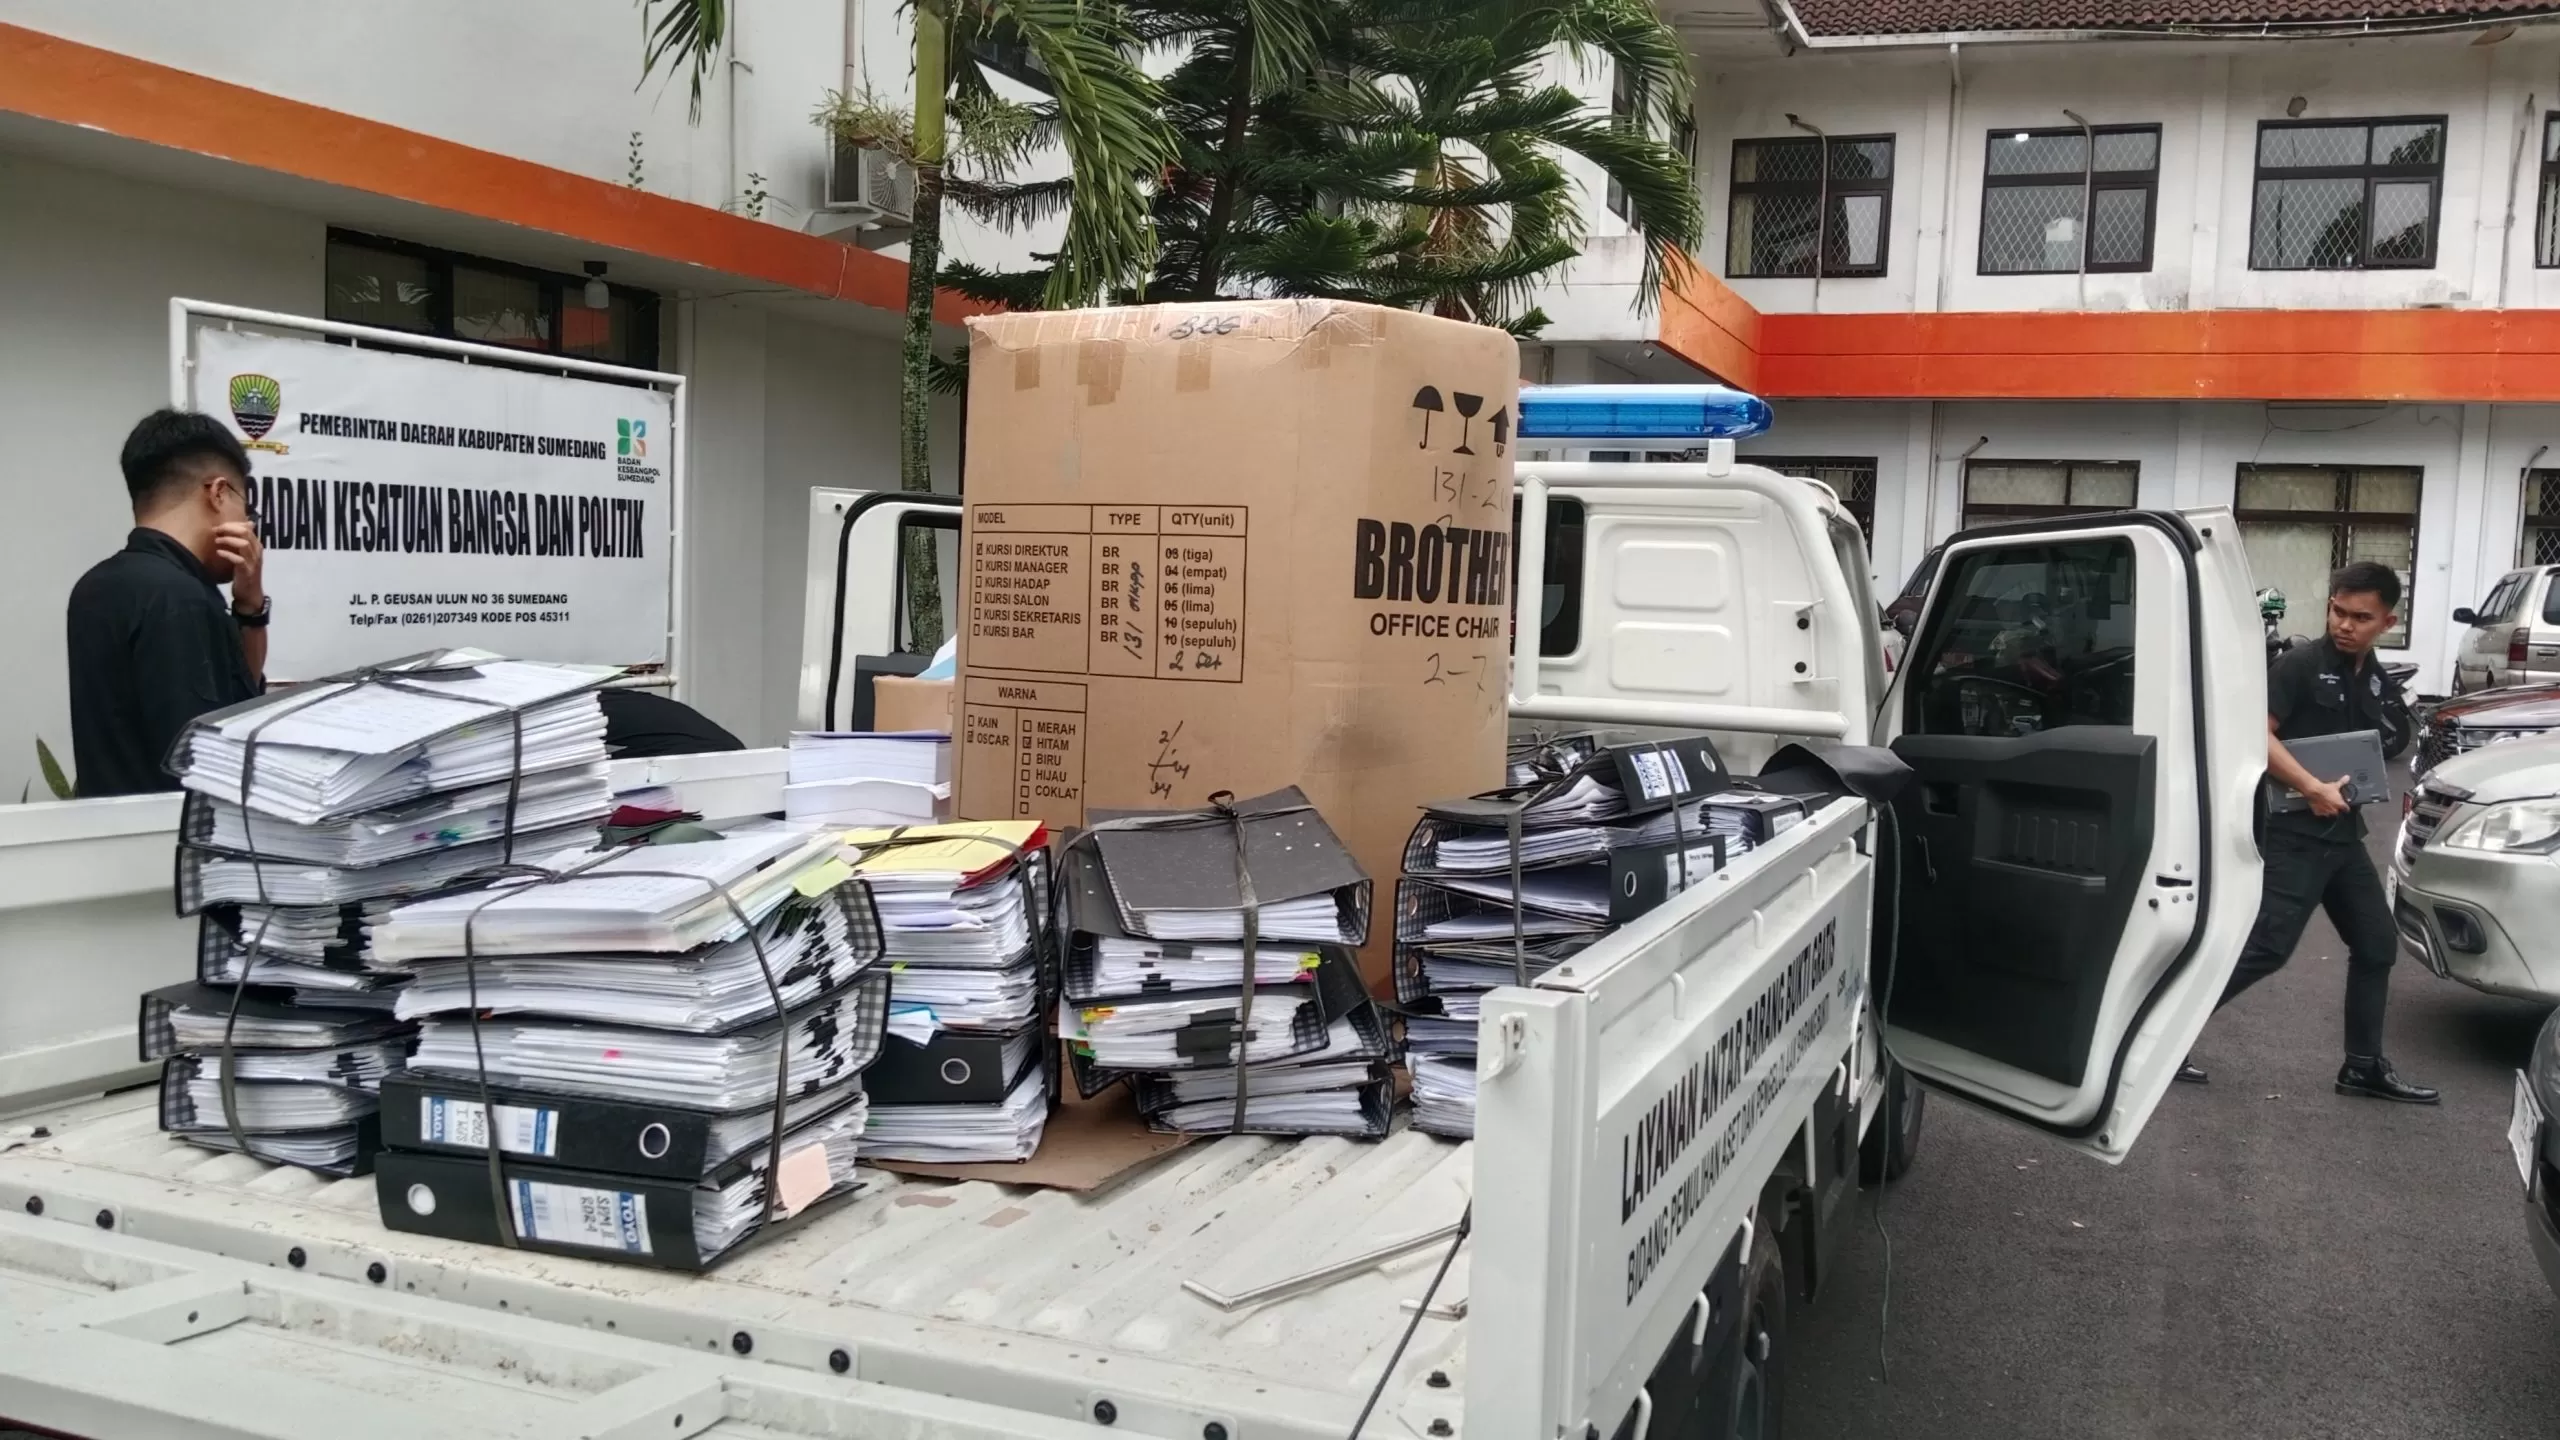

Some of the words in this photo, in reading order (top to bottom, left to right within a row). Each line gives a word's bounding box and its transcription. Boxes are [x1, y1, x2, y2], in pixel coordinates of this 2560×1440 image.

[300, 412, 397, 442] PEMERINTAH
[400, 421, 455, 447] DAERAH
[458, 427, 535, 455] KABUPATEN
[537, 435, 606, 460] SUMEDANG
[617, 456, 641, 466] BADAN
[617, 466, 661, 476] KESBANGPOL
[617, 473, 655, 484] SUMEDANG
[333, 481, 443, 554] KESATUAN
[447, 487, 531, 557] BANGSA
[535, 491, 574, 557] DAN
[578, 495, 645, 559] POLITIK
[977, 512, 1006, 524] MODEL
[1109, 513, 1142, 526] TYPE
[1171, 513, 1235, 529] QTY(unit)
[986, 544, 1012, 555] KURSI
[1014, 544, 1069, 557] DIREKTUR
[1102, 546, 1120, 558] BR
[1182, 549, 1213, 563] (tiga)
[1354, 518, 1509, 606] BROTHER
[985, 560, 1012, 572] KURSI
[1014, 561, 1068, 574] MANAGER
[1102, 563, 1120, 575] BR
[1182, 565, 1227, 580] (empat)
[985, 577, 1011, 589] KURSI
[1013, 578, 1050, 590] HADAP
[1101, 580, 1119, 592] BR
[1181, 583, 1215, 598] (lima)
[349, 594, 367, 605] JL.
[371, 594, 380, 605] P.
[384, 594, 432, 605] GEUSAN
[436, 594, 468, 605] ULUN
[471, 594, 488, 604] NO
[491, 594, 505, 604] 36
[507, 594, 568, 604] SUMEDANG
[984, 594, 1011, 606] KURSI
[1013, 594, 1049, 607] SALON
[1101, 597, 1119, 609] BR
[1181, 600, 1214, 615] (lima)
[349, 613, 398, 627] Telp/Fax
[401, 612, 478, 626] (0261)207349
[481, 612, 512, 623] KODE
[515, 612, 537, 622] POS
[539, 611, 570, 622] 45311
[983, 610, 1011, 623] KURSI
[1012, 611, 1081, 625] SEKRETARIS
[1101, 614, 1119, 626] BR
[1181, 617, 1237, 634] (sepuluh)
[1370, 612, 1449, 637] OFFICE
[1455, 617, 1500, 638] CHAIR
[983, 626, 1010, 638] KURSI
[1012, 627, 1035, 639] BAR
[1100, 631, 1118, 643] BR
[1180, 634, 1236, 651] (sepuluh)
[998, 686, 1037, 700] WARNA
[977, 716, 998, 729] KAIN
[1037, 722, 1076, 735] MERAH
[976, 732, 1010, 746] OSCAR
[1036, 738, 1069, 751] HITAM
[1036, 754, 1062, 767] BIRU
[1035, 769, 1067, 783] HIJAU
[1035, 785, 1079, 800] COKLAT
[1621, 1060, 1697, 1226] LAYANAN
[1699, 1014, 1742, 1132] ANTAR
[1744, 970, 1784, 1076] BARANG
[1785, 941, 1810, 1025] BUKTI
[1811, 914, 1835, 993] GRATIS
[432, 1104, 443, 1139] TOYO
[1627, 1202, 1668, 1307] BIDANG
[1670, 1134, 1720, 1247] PEMULIHAN
[1721, 1108, 1740, 1175] ASET
[620, 1199, 638, 1243] TOYO
